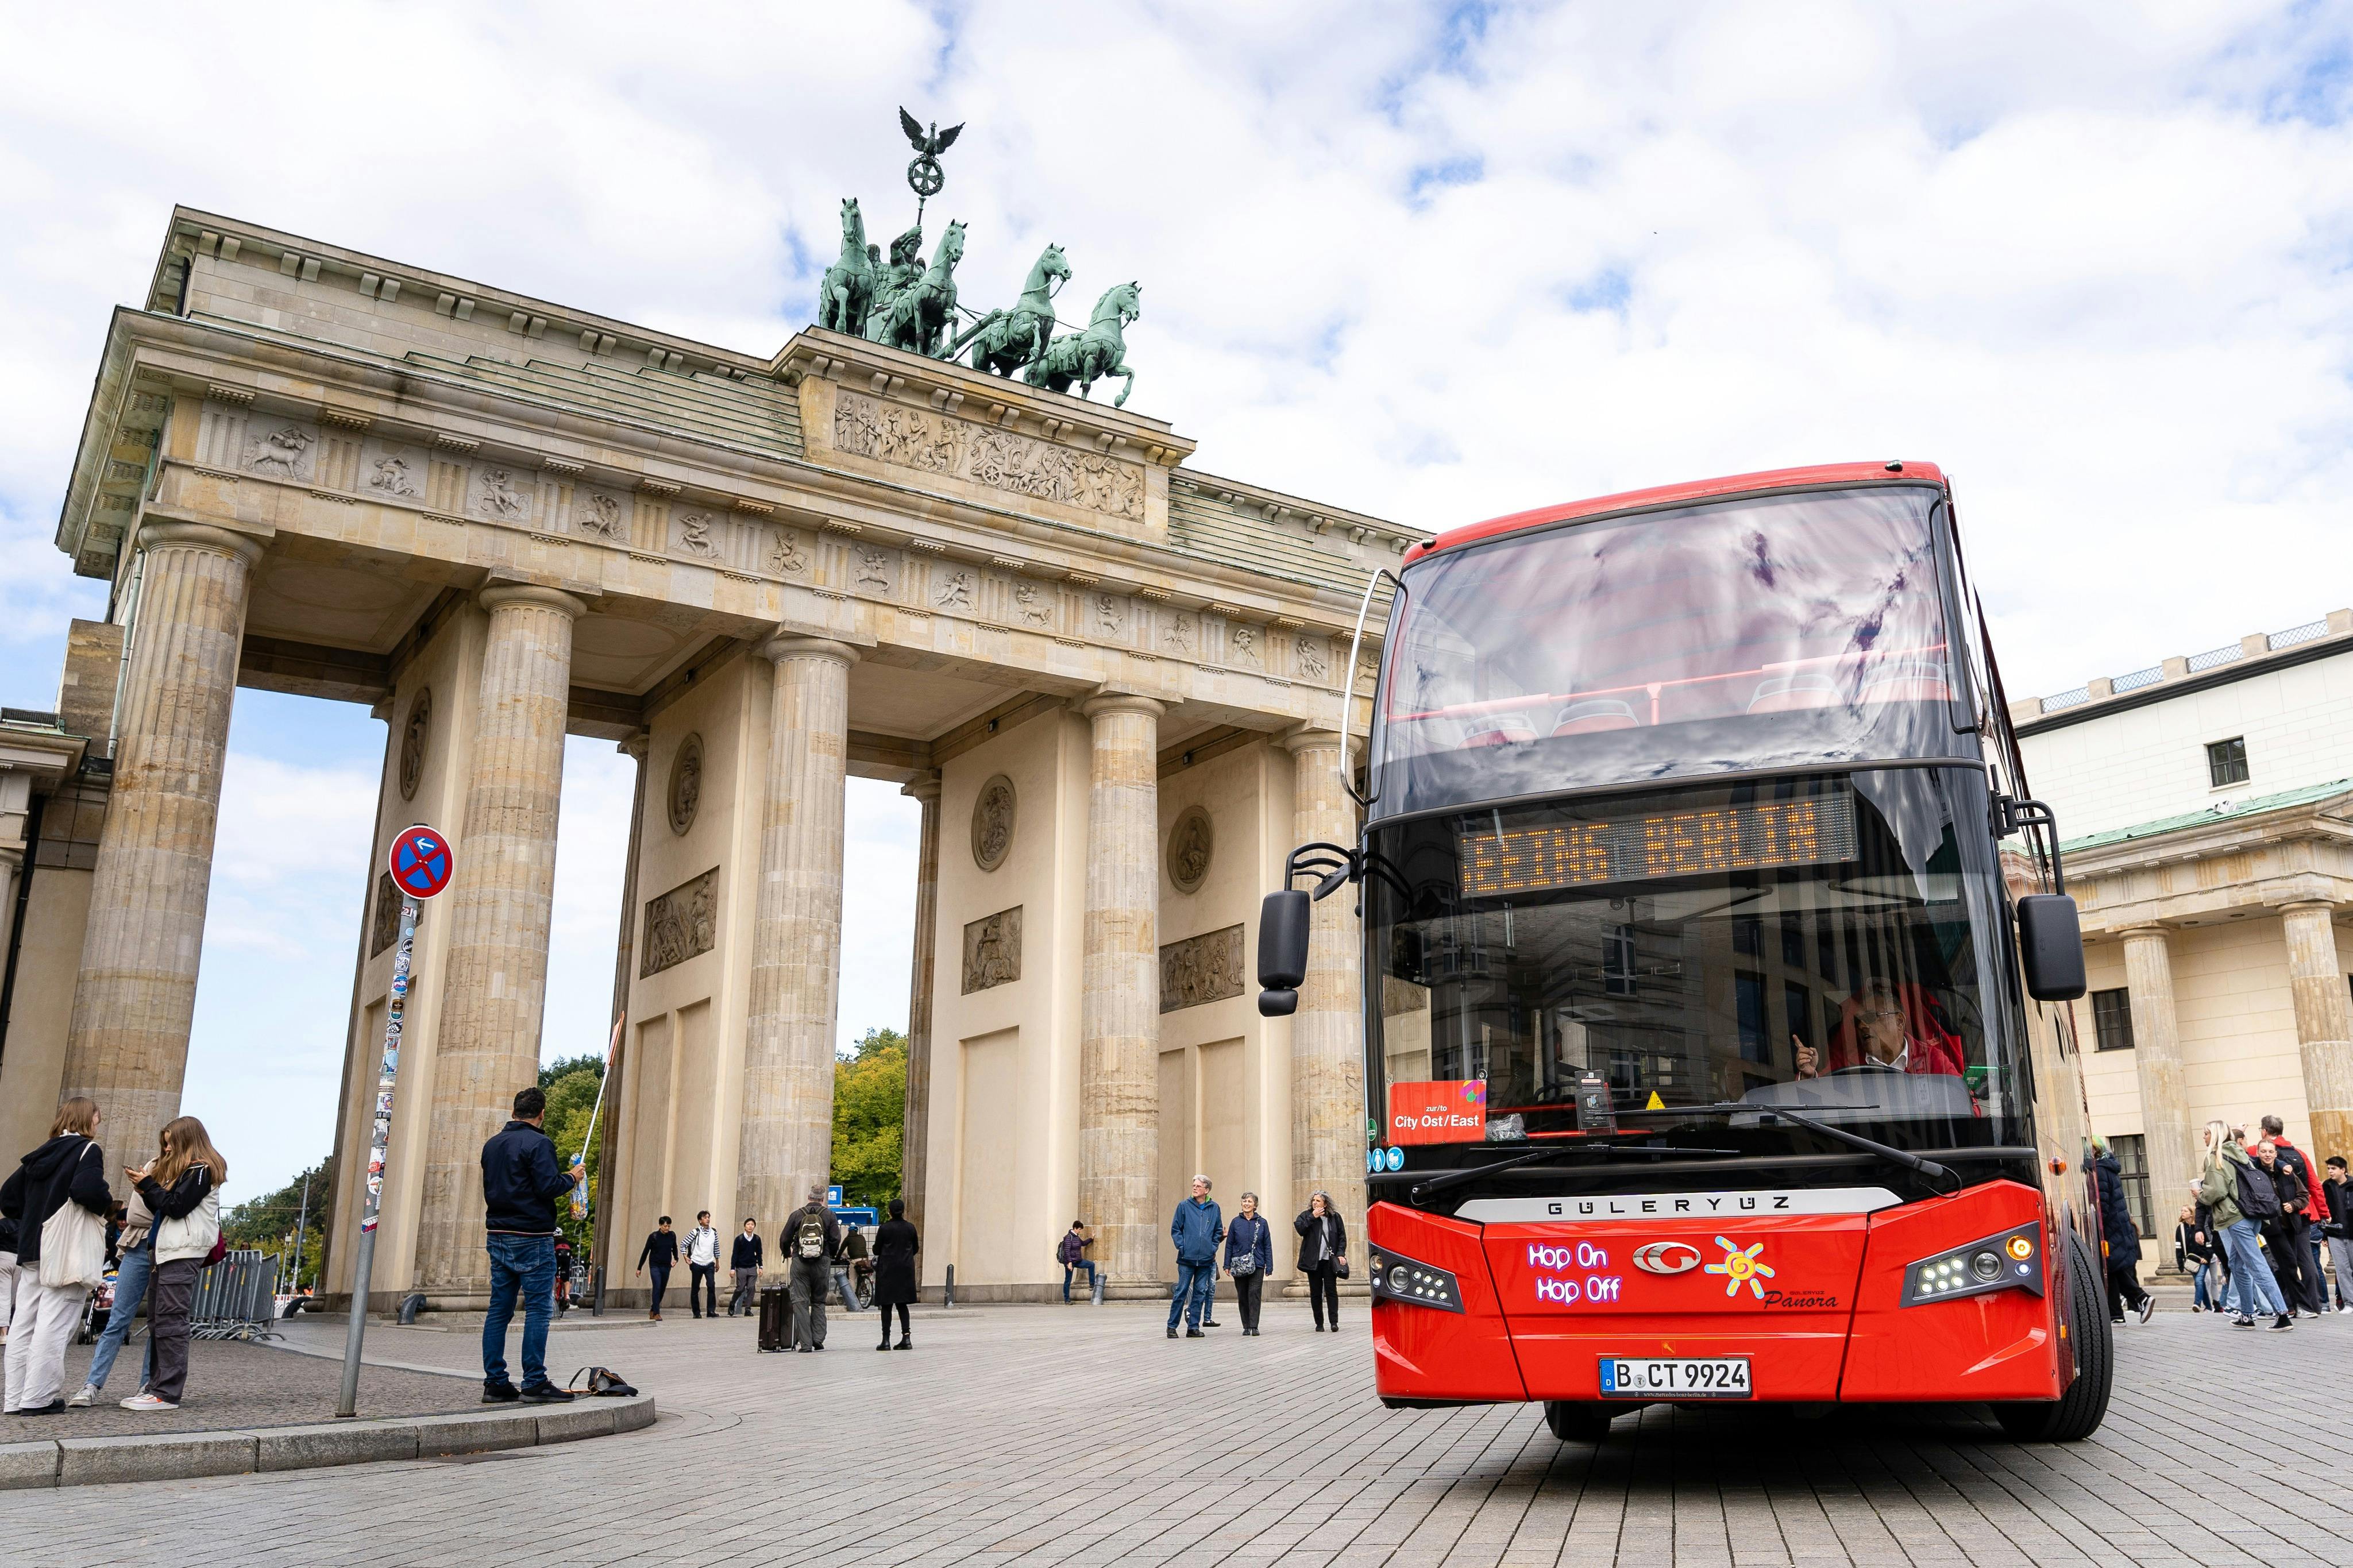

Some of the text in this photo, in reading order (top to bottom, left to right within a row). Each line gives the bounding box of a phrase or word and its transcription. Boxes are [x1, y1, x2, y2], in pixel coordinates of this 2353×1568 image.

[1463, 802, 1815, 892] EEING BERLIN
[1395, 1115, 1418, 1130] City
[1548, 1196, 1789, 1215] GÜLERYÜZ
[1527, 1241, 1608, 1271] Hop On
[1536, 1275, 1622, 1305] Hop Off
[1764, 1290, 1838, 1309] Panora
[1617, 1364, 1745, 1387] B CT 9924
